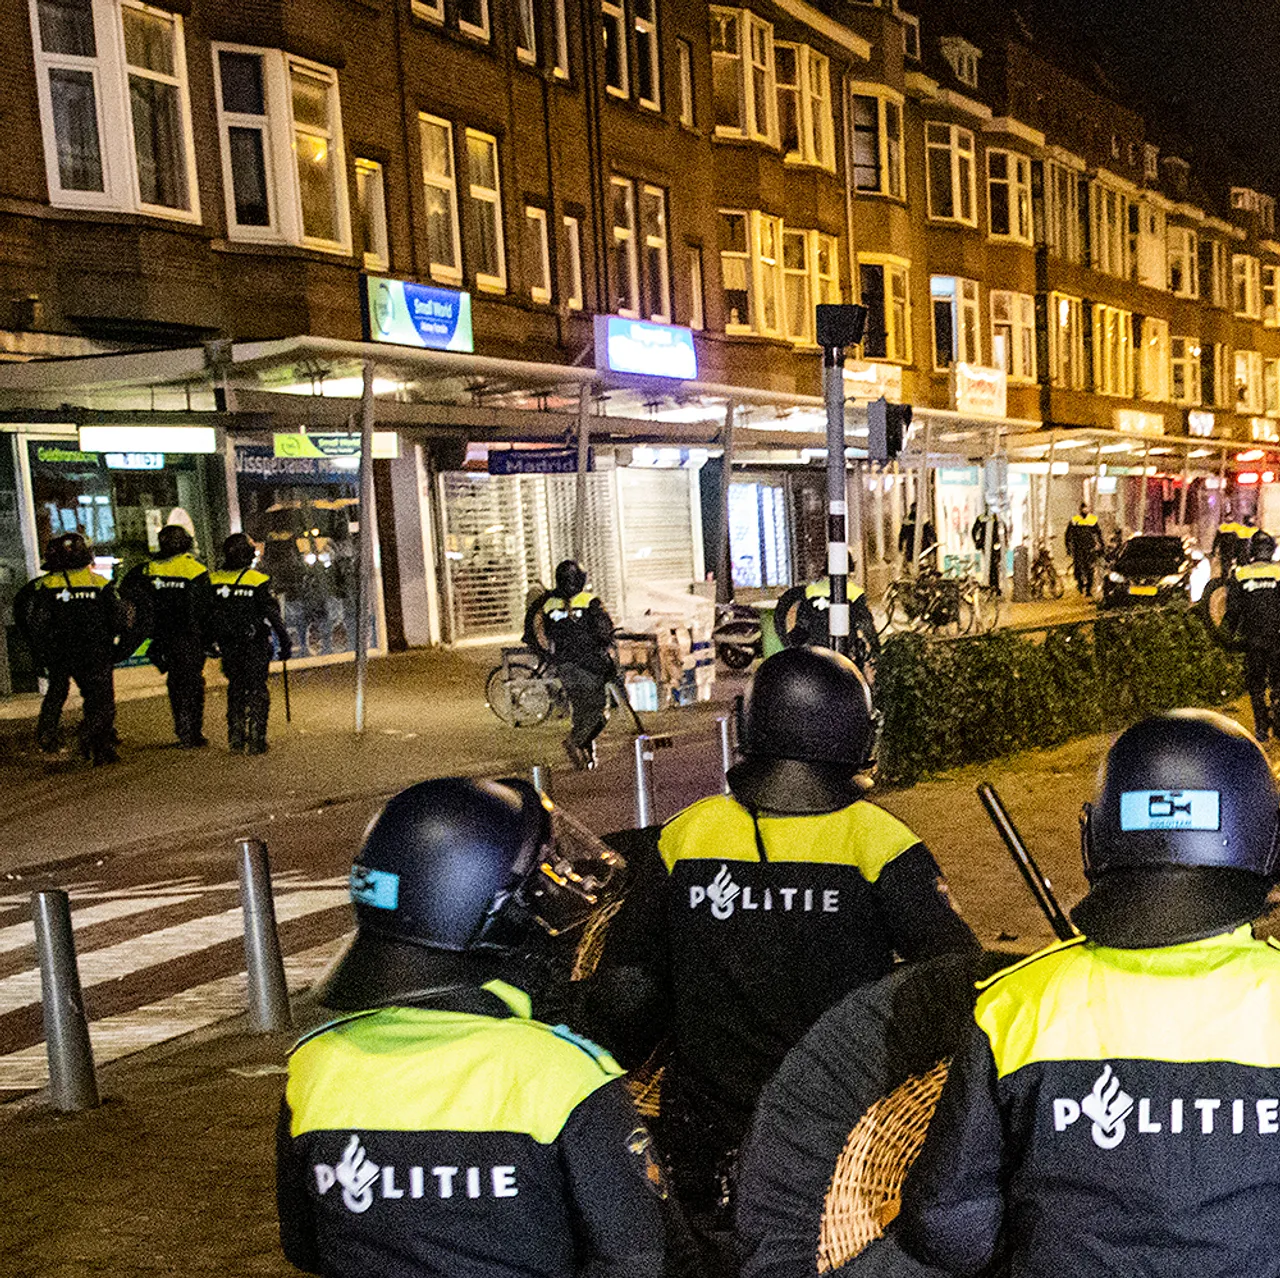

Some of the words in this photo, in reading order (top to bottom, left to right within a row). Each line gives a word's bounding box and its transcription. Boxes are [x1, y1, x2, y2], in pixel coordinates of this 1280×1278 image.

[689, 863, 840, 920] POLITIE
[1054, 1065, 1279, 1149] POLITIE
[314, 1134, 519, 1213] POLITIE
